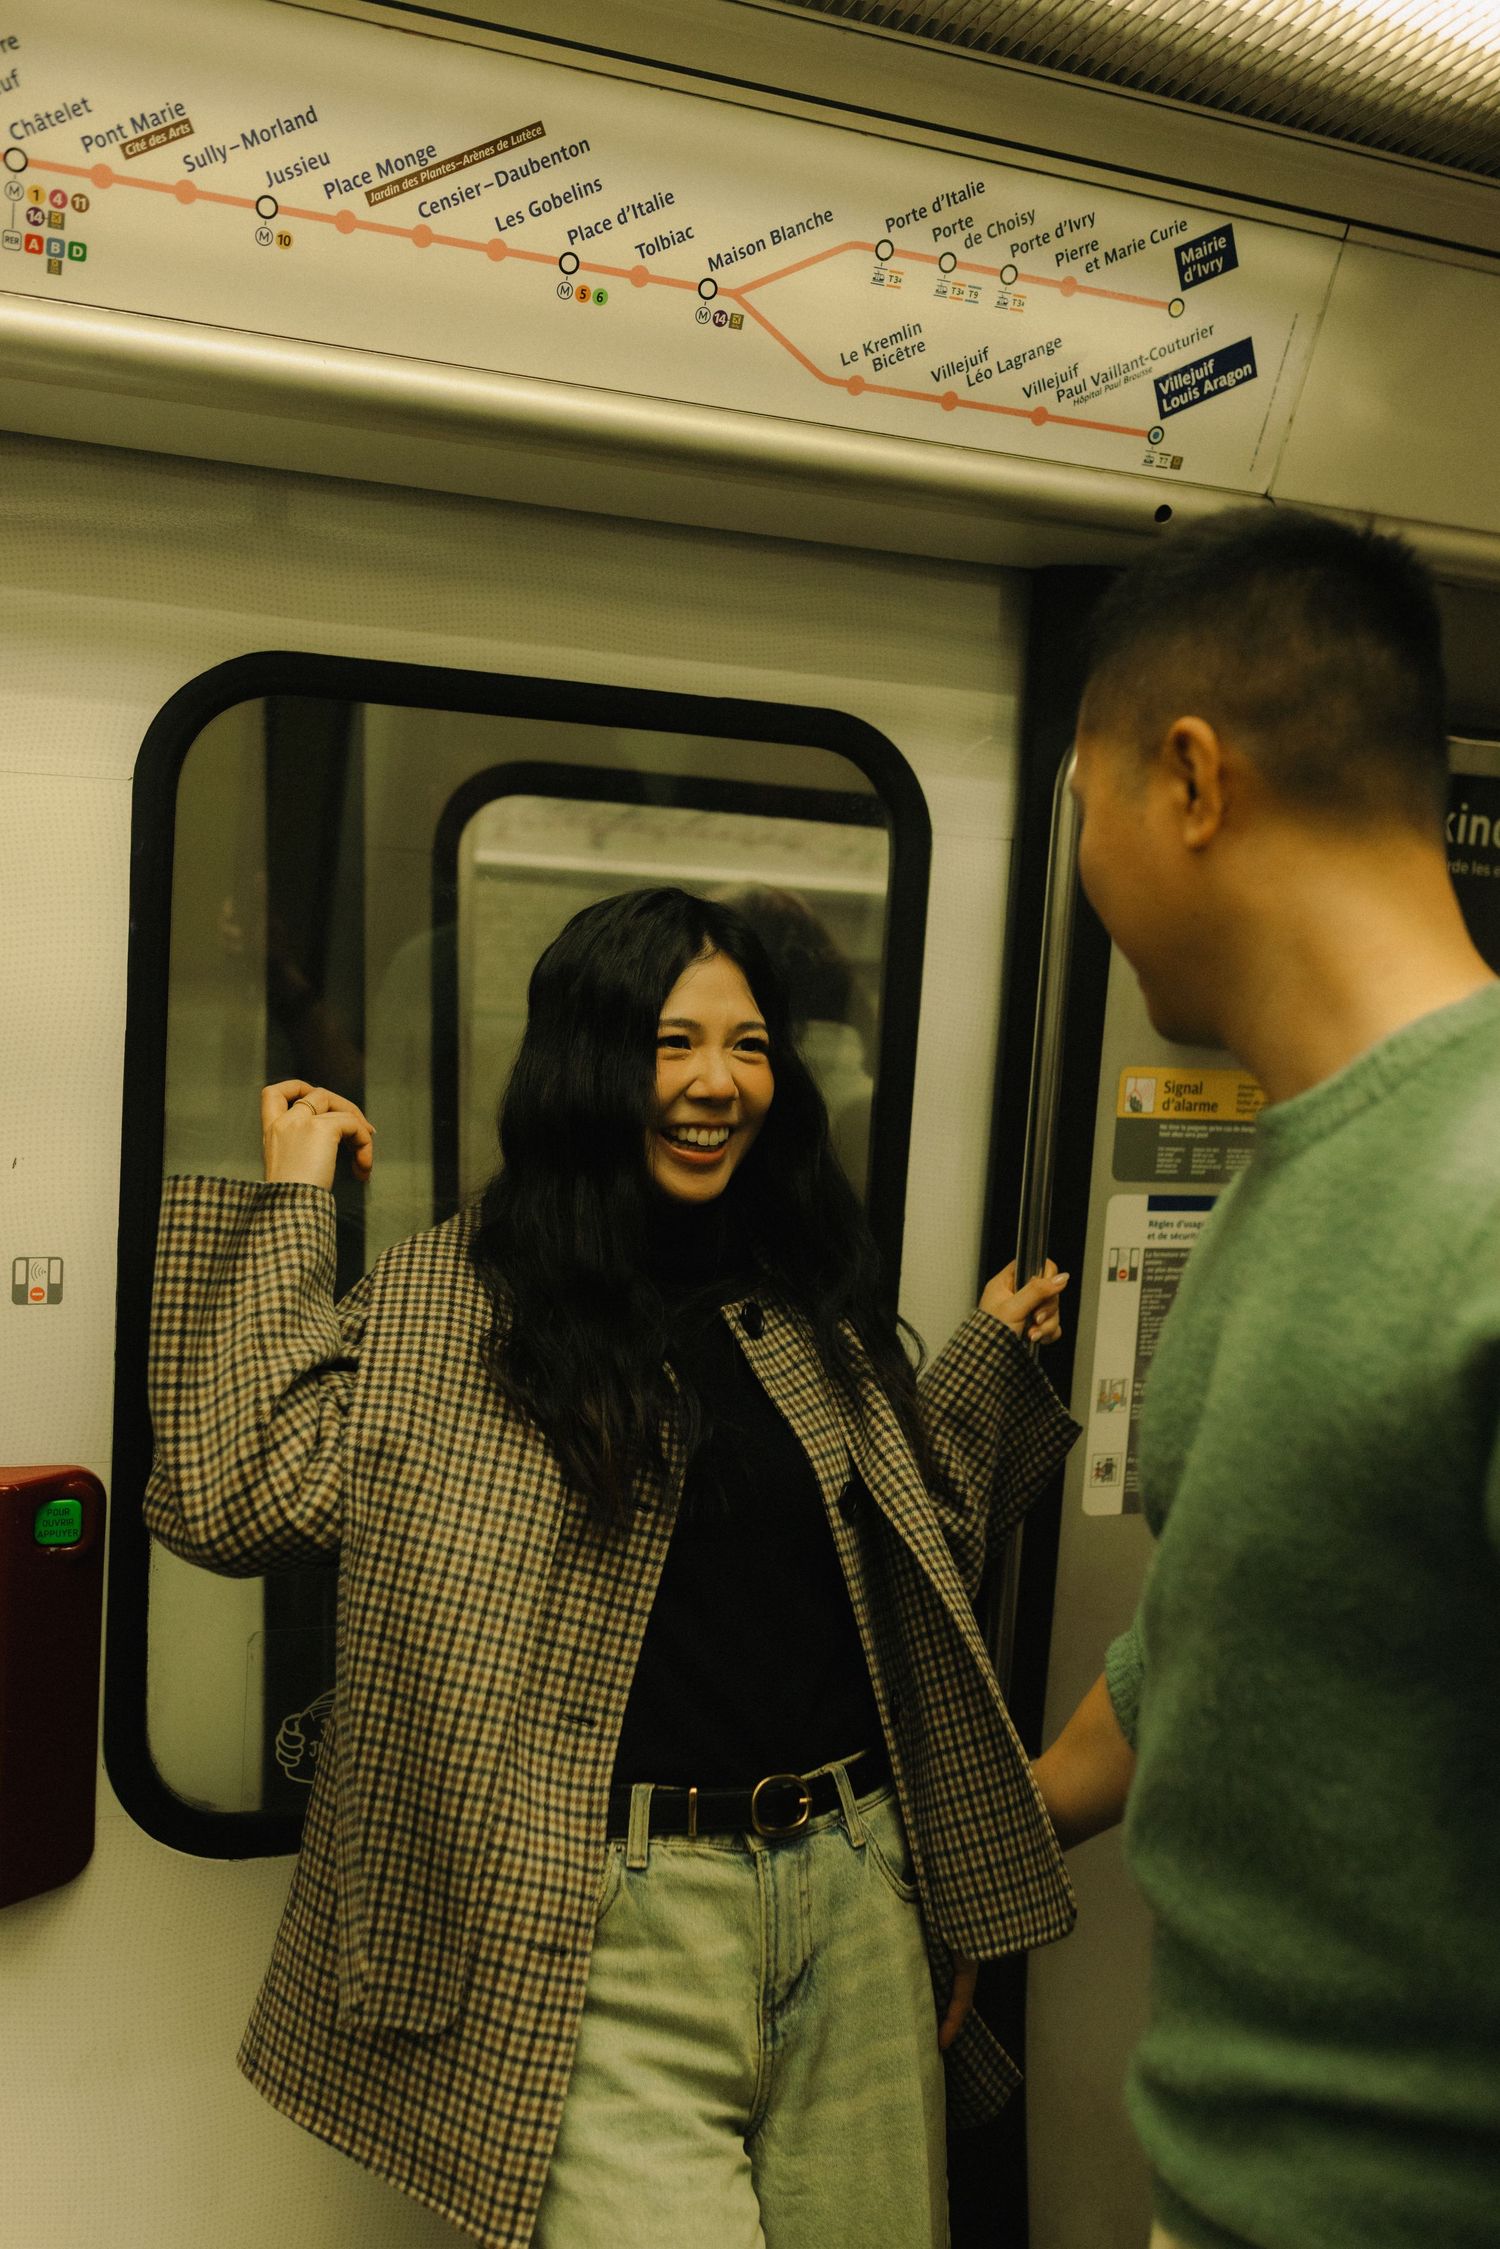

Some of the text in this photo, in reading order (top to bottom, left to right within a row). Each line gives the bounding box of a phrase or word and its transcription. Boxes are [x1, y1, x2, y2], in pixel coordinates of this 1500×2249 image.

[9, 97, 93, 141] Châtelet
[80, 101, 187, 153] Pont Marie
[124, 123, 191, 157] Cité des Arts
[265, 152, 331, 188] Jussieu
[323, 145, 437, 199] Place Monge
[369, 184, 400, 204] Jardin
[401, 177, 419, 191] des
[496, 138, 509, 151] de
[510, 124, 542, 146] Lutèce
[28, 209, 44, 224] 14
[73, 196, 87, 210] 11
[494, 177, 603, 232] Les Gobelins
[885, 206, 928, 233] Porte
[277, 234, 291, 247] 10
[567, 218, 613, 246] Place
[634, 225, 695, 259] Tolbiac
[707, 209, 834, 272] Maison Blanche
[931, 216, 974, 242] Porte
[964, 209, 1036, 249] de Choisy
[1010, 231, 1051, 258] Porte
[1085, 219, 1188, 274] et Marie Curie
[1054, 239, 1100, 267] Pierre
[1180, 234, 1228, 266] Mairie
[714, 313, 727, 325] 14
[840, 322, 923, 367] Le Kremlin
[872, 340, 926, 373] Bicêtre
[931, 346, 990, 383] Villejuif
[966, 337, 1063, 388] Léo Lagrange
[1056, 324, 1215, 403] Paul Vaillant-Couturier
[1158, 358, 1216, 396] Villejuif
[1022, 362, 1080, 399] Villejuif
[1073, 366, 1153, 408] Hôpital Paul Brousse
[1162, 363, 1253, 413] Louis Aragon
[1163, 1080, 1204, 1097] Signal
[42, 1518, 74, 1528] OUVRIR
[47, 1507, 71, 1517] POUR
[37, 1528, 79, 1538] APPUYER
